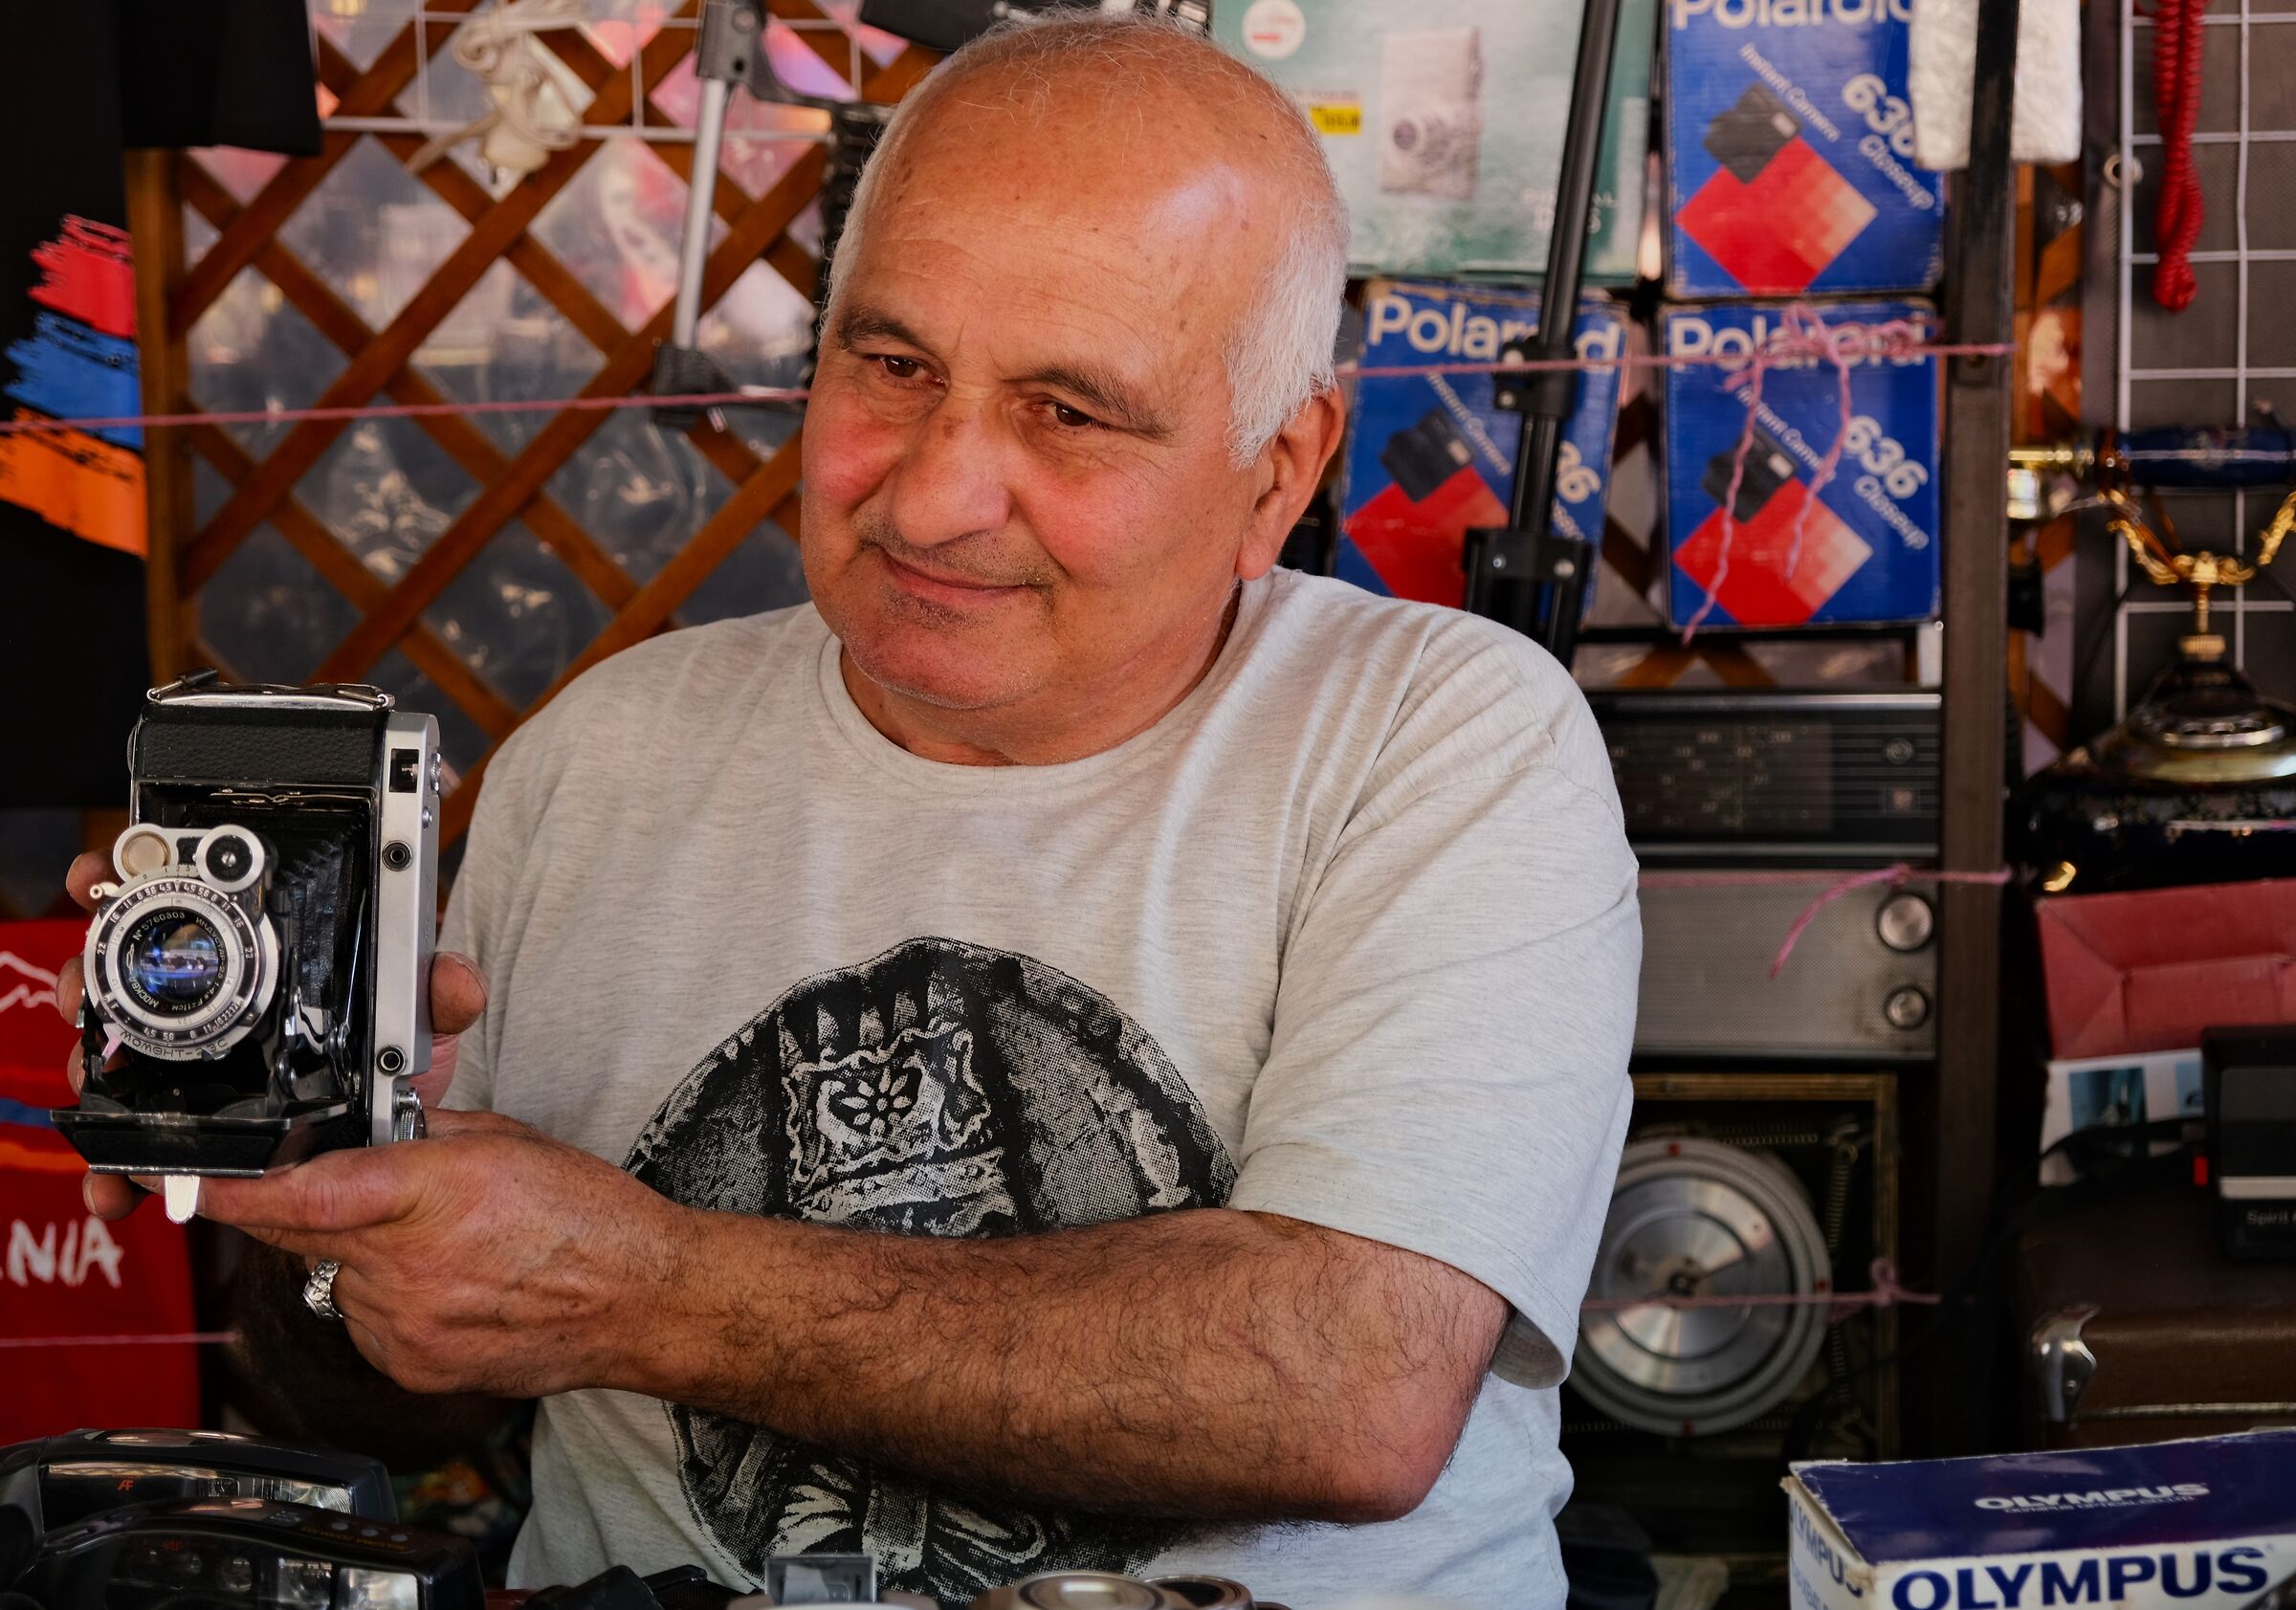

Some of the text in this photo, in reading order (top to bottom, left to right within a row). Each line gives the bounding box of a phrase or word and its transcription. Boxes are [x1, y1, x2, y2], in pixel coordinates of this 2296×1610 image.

[1367, 295, 1621, 374] Polard
[1844, 415, 1929, 498] 636
[1853, 475, 1930, 550] Closeup
[2245, 1208, 2288, 1227] Spirit
[0, 1215, 124, 1289] NIA
[117, 1479, 134, 1491] AF
[1974, 1483, 2210, 1511] OLYMPUS
[1891, 1547, 2268, 1610] OLYMPUS
